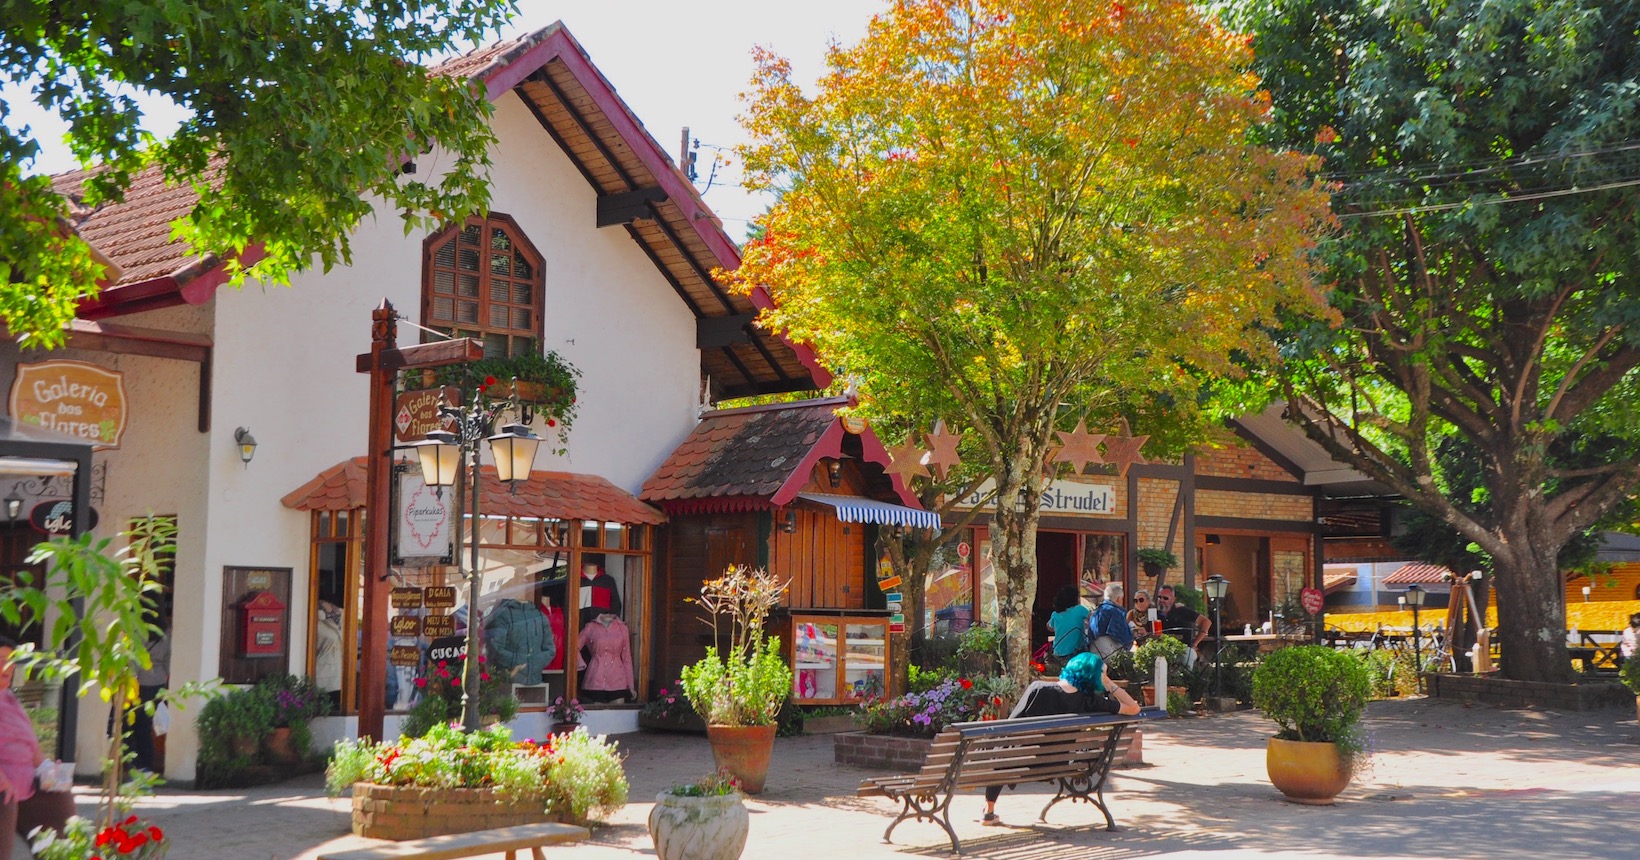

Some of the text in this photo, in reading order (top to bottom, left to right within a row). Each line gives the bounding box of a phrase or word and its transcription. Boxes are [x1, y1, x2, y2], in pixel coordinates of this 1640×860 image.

[33, 375, 108, 408] Galeria
[58, 402, 82, 415] das
[409, 391, 440, 415] Galeri
[420, 411, 432, 419] das
[1040, 486, 1107, 511] Strudel
[409, 506, 443, 518] Piparkukas
[393, 616, 417, 632] igloo
[424, 627, 438, 636] COM
